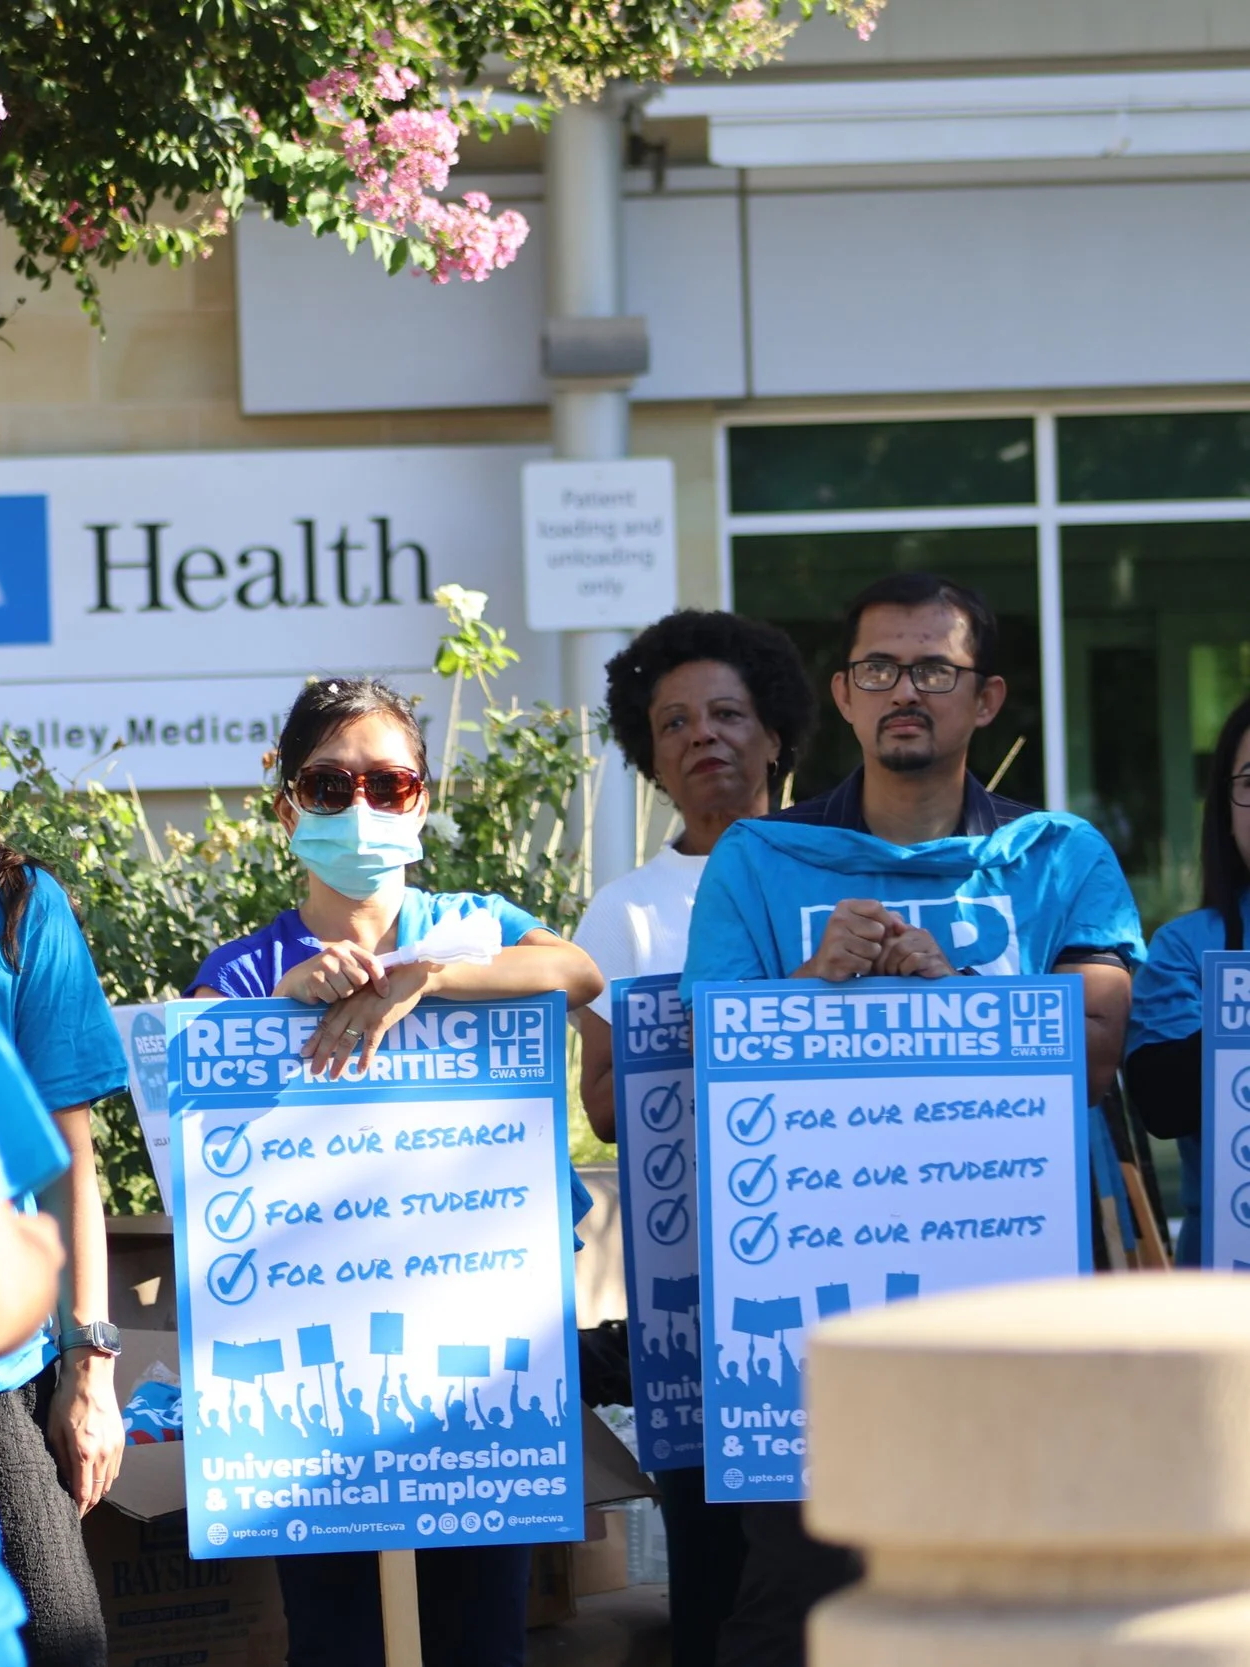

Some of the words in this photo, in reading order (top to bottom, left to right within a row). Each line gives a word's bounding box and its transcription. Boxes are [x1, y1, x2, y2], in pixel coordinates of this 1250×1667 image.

[562, 488, 635, 507] Patient
[539, 521, 616, 541] loading
[626, 519, 663, 536] and
[87, 517, 434, 614] Health
[547, 549, 654, 570] unloading
[578, 578, 623, 598] only
[128, 714, 279, 746] Medical
[628, 990, 690, 1027] RE
[713, 991, 1001, 1034] RESETTING
[1012, 993, 1059, 1018] UP
[186, 1010, 479, 1057] RESEING
[491, 1010, 542, 1038] UP
[1013, 1019, 1061, 1044] TE
[491, 1038, 542, 1067] TE
[713, 1034, 793, 1062] UC'S
[804, 1031, 1001, 1059] PRIORITIES
[1011, 1048, 1037, 1056] CWA
[1040, 1047, 1064, 1056] 9119
[187, 1058, 268, 1087] UC'S
[490, 1068, 517, 1079] CWA
[519, 1067, 545, 1078] 9119
[784, 1108, 837, 1131] FOR
[847, 1103, 902, 1127] OUR
[914, 1096, 1045, 1123] RESEARCH
[261, 1137, 315, 1161] FOR
[327, 1132, 384, 1156] OUR
[394, 1121, 526, 1151] RESEARCH
[786, 1165, 843, 1192] FOR
[852, 1164, 908, 1188] OUR
[918, 1157, 1048, 1184] STUDENTS
[265, 1199, 324, 1226] FOR
[334, 1196, 391, 1221] OUR
[400, 1186, 529, 1216] STUDENTS
[788, 1223, 844, 1250] FOR
[854, 1221, 910, 1246] OUR
[920, 1215, 1046, 1242] PATIENTS
[267, 1261, 325, 1288] FOR
[336, 1259, 394, 1283] OUR
[405, 1248, 529, 1278] PATIENTS
[646, 1375, 702, 1402] Univ
[650, 1408, 669, 1429] &
[674, 1404, 703, 1426] Te
[721, 1403, 807, 1429] Unive
[202, 1449, 366, 1480] University
[374, 1441, 567, 1475] Professional
[722, 1435, 744, 1457] &
[752, 1435, 806, 1456] Tec
[205, 1488, 228, 1512] &
[235, 1479, 389, 1510] Technical
[399, 1475, 567, 1508] Employees
[748, 1474, 794, 1484] upte.org
[232, 1526, 279, 1541] upte.org
[311, 1522, 406, 1536] fb.com/UPTEcwa
[507, 1513, 564, 1528] @uptecwa
